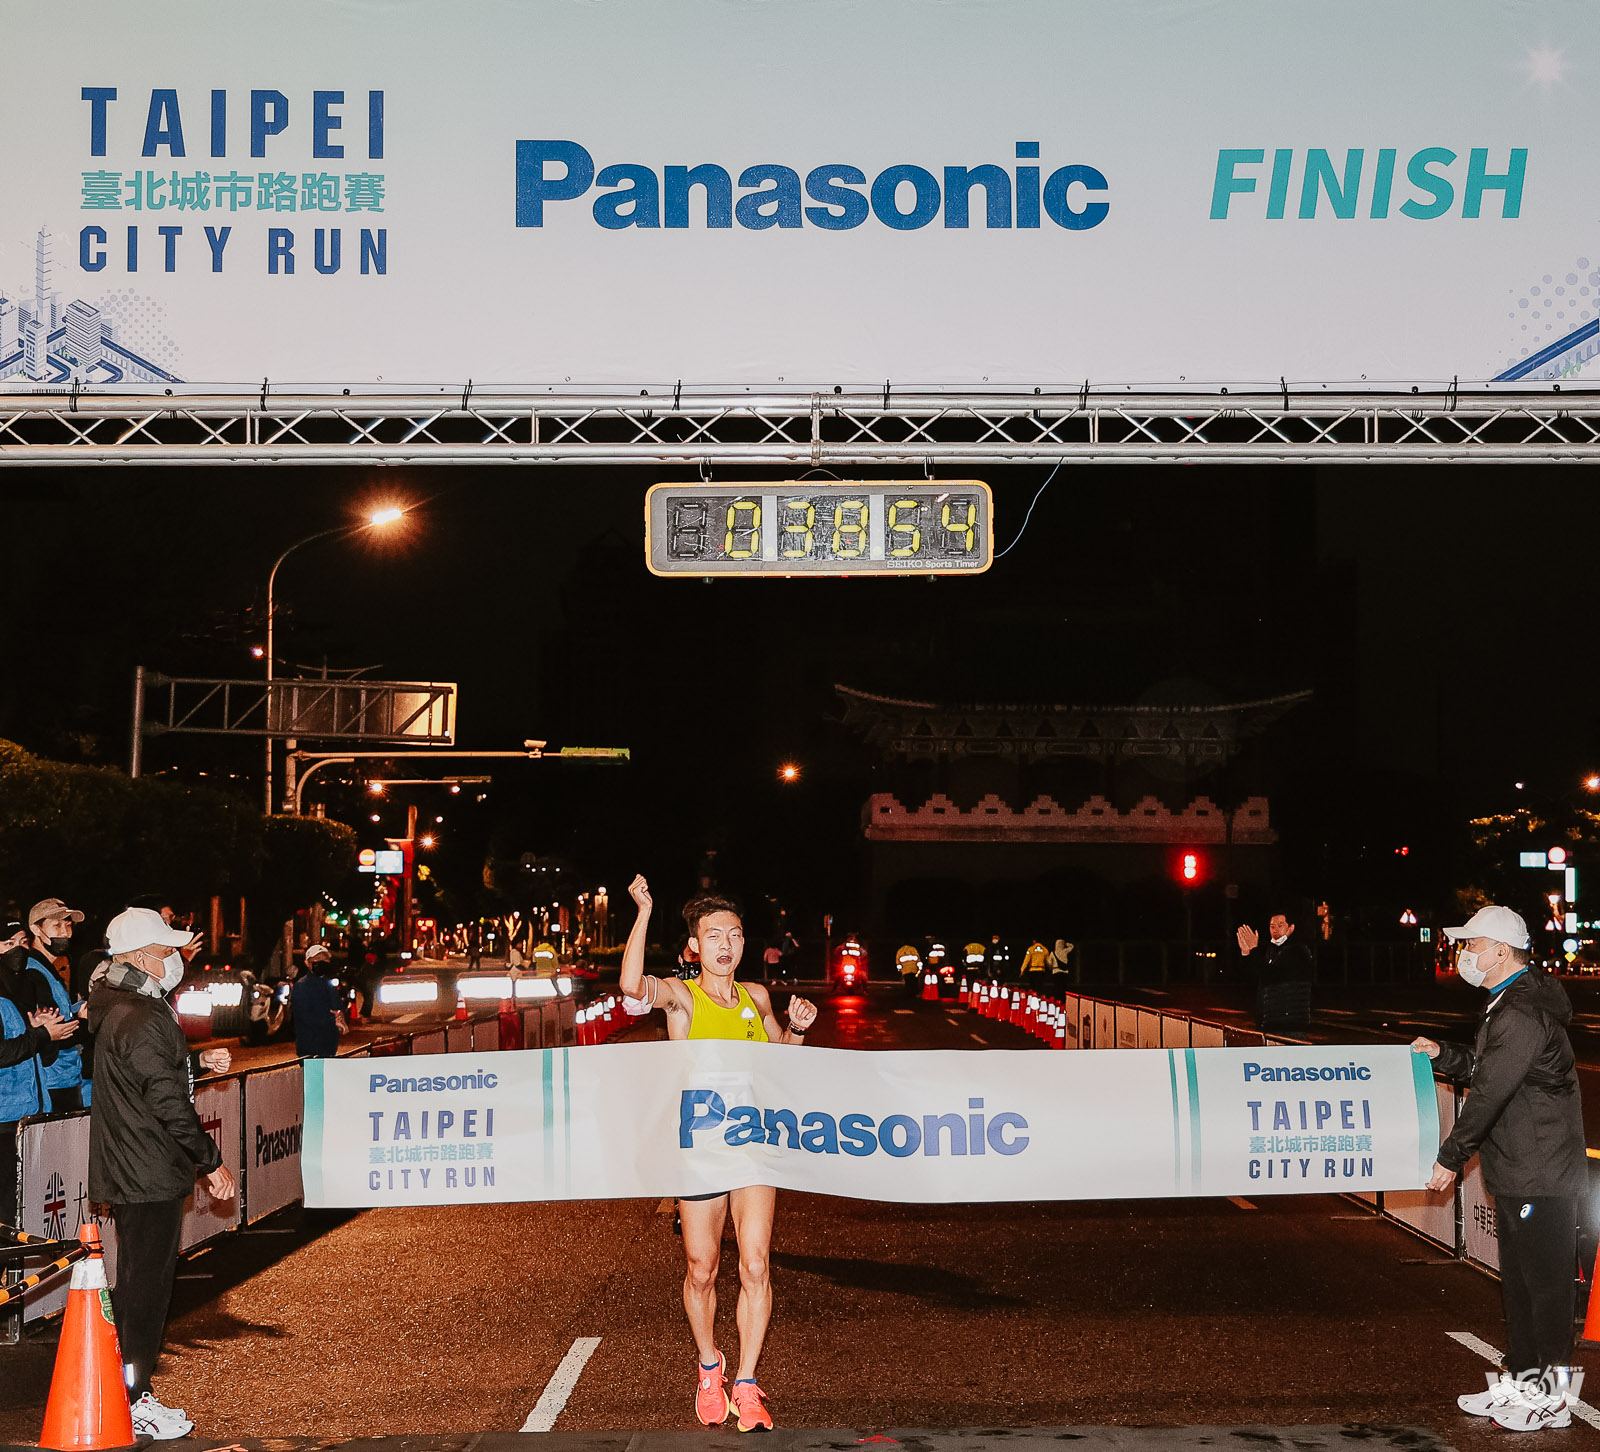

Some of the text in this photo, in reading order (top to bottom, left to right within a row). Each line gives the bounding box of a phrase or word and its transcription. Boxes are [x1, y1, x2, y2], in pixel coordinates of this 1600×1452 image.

[81, 87, 385, 159] TAIPEI
[80, 169, 386, 213] 臺北城市路跑賽
[515, 139, 1110, 231] Panasonic
[1209, 146, 1529, 220] FINISH
[79, 225, 388, 275] CITY RUN
[886, 560, 979, 569] SEIKO Sports Timer
[369, 1068, 498, 1093] Panasonic
[1243, 1061, 1371, 1082] Panasonic
[368, 1108, 494, 1142] TAIPEI
[678, 1089, 1030, 1157] Panasonic
[1246, 1099, 1371, 1131] TAIPEI
[368, 1142, 494, 1164] 臺北城市路跑賽
[1248, 1134, 1372, 1154] 臺北城市路跑賽
[368, 1165, 495, 1191] CITY RUN
[1248, 1158, 1373, 1179] CITY RUN
